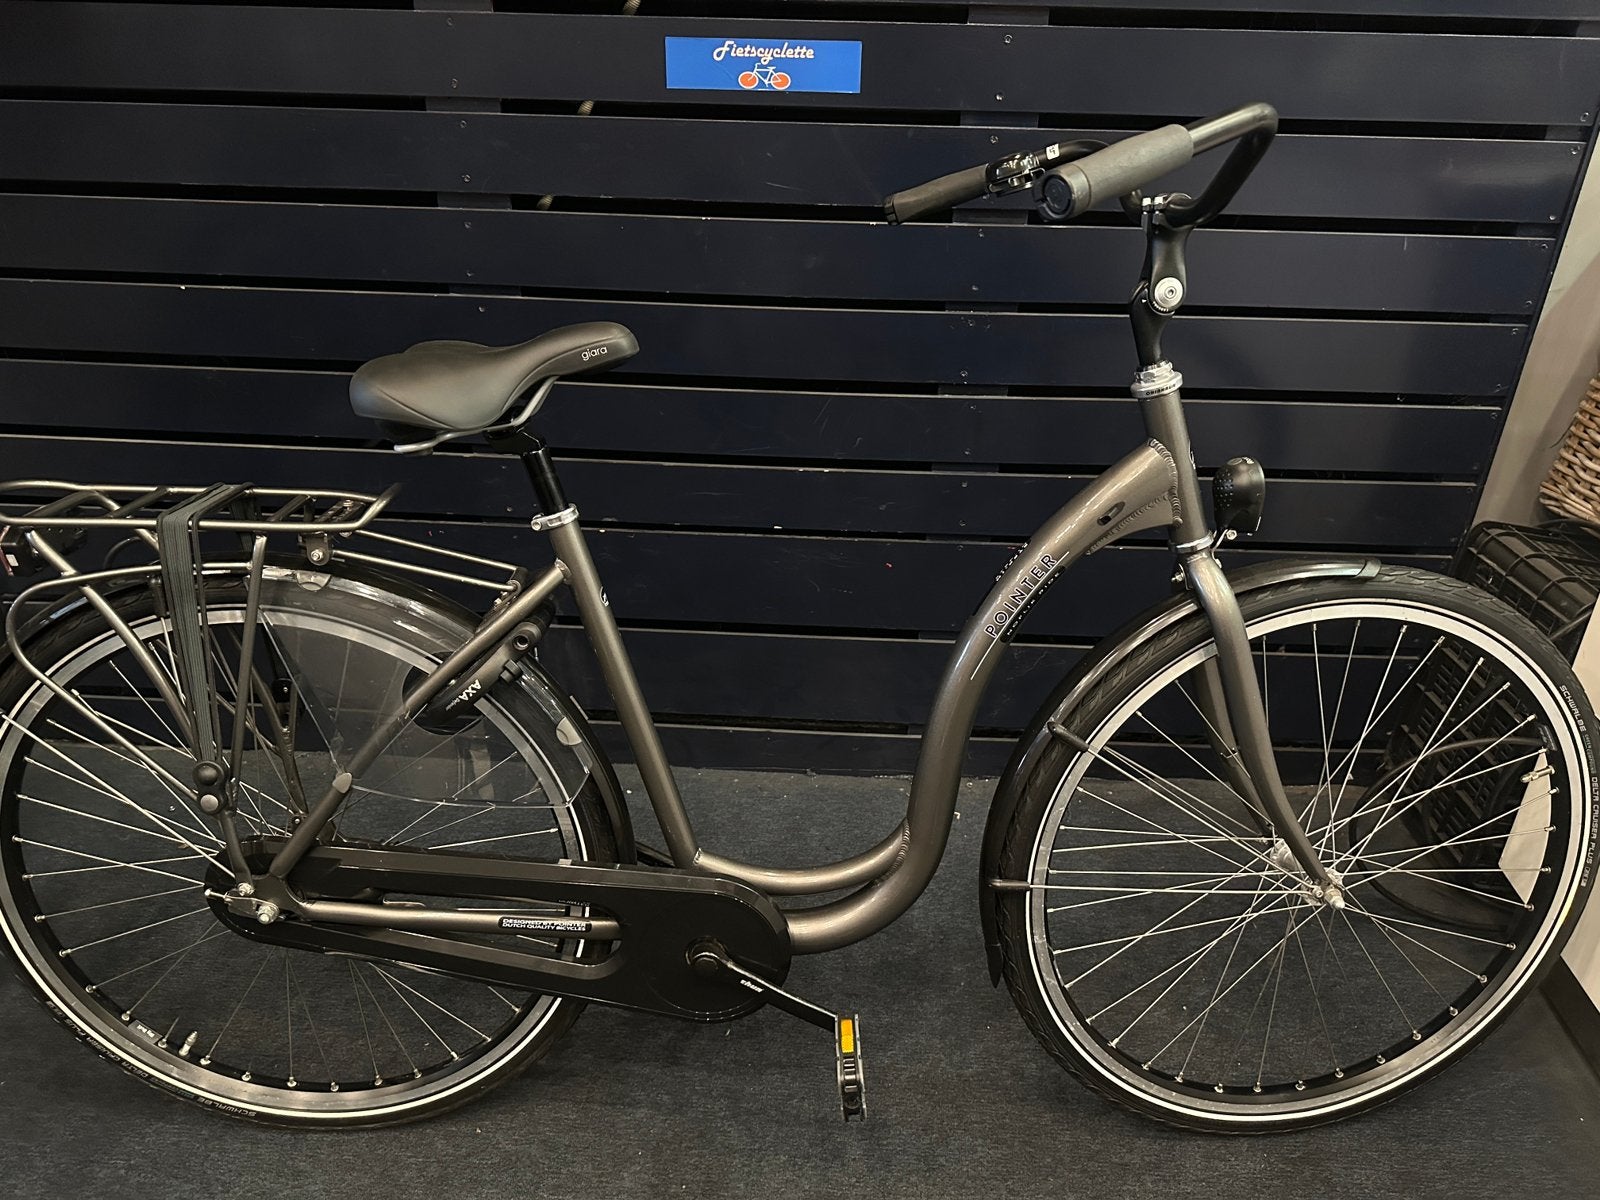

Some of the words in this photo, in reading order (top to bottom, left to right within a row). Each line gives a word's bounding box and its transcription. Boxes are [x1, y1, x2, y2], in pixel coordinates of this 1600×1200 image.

[712, 40, 815, 65] Fietscyclette
[581, 346, 608, 361] giara
[984, 553, 1058, 638] POINTER
[458, 679, 482, 701] AXA
[1560, 685, 1587, 732] SCHWALBE
[1592, 776, 1600, 801] DELTA
[1591, 804, 1600, 839] CRUISER
[1586, 841, 1596, 864] PLUS
[64, 1018, 87, 1036] PLUS
[197, 1097, 257, 1117] SCHWALBE
